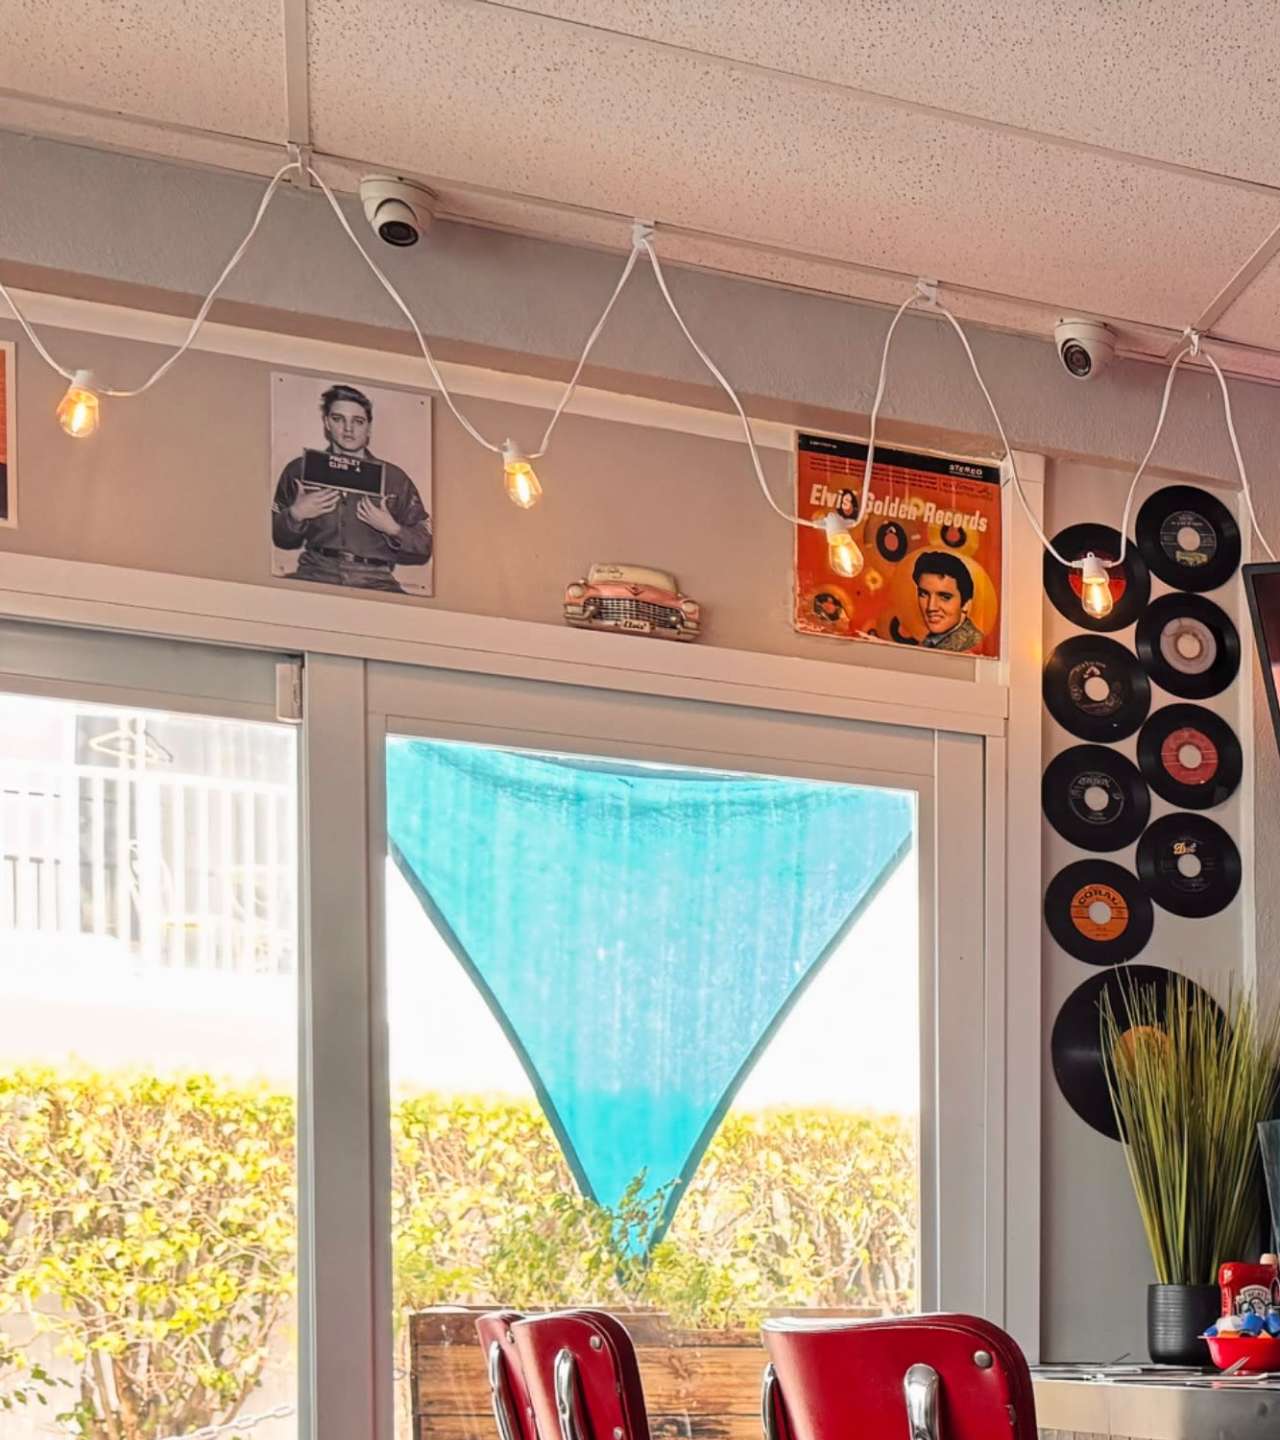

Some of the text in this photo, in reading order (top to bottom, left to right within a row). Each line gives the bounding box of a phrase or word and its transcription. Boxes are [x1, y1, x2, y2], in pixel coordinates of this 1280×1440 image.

[949, 463, 983, 476] STEREO
[863, 492, 917, 521] Golden
[923, 502, 988, 532] Records
[1078, 890, 1118, 906] CORAL
